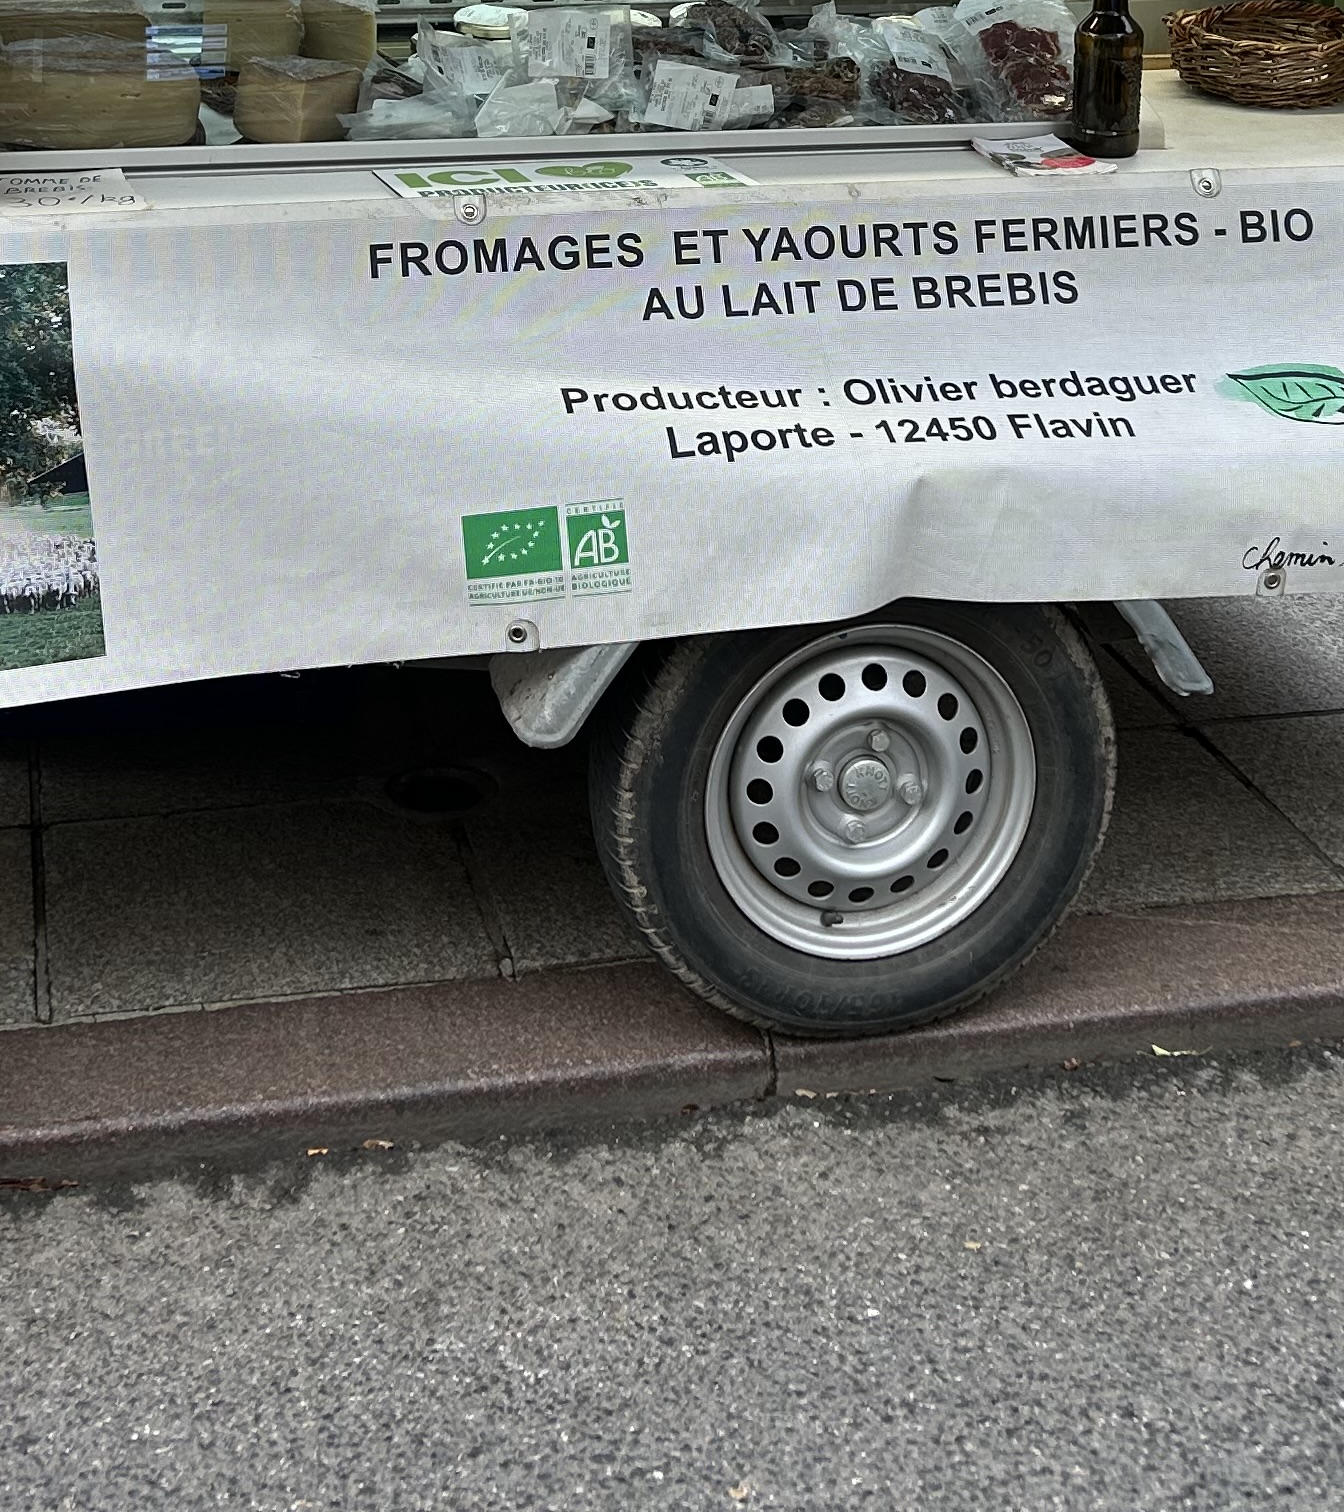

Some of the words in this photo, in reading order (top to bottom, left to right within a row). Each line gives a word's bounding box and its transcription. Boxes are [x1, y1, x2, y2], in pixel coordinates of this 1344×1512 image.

[394, 168, 533, 188] ICI
[368, 233, 645, 279] FROMAGES
[671, 228, 727, 267] ET
[744, 219, 960, 265] YAOURTS
[975, 212, 1201, 258] FERMIERS
[1240, 208, 1315, 247] BIO
[642, 285, 708, 322] AU
[723, 280, 820, 318] LAIT
[840, 277, 899, 314] DE
[914, 269, 1080, 310] BREBIS
[561, 381, 805, 417] Producteur
[843, 374, 977, 409] Olivier
[989, 368, 1199, 408] berdaguer
[667, 421, 836, 463] Laporte
[875, 414, 998, 446] 12450
[1011, 411, 1136, 441] Flavin
[574, 528, 619, 566] AB
[572, 568, 631, 580] AGRICULTURE
[572, 577, 632, 590] BIOLOGIQUE
